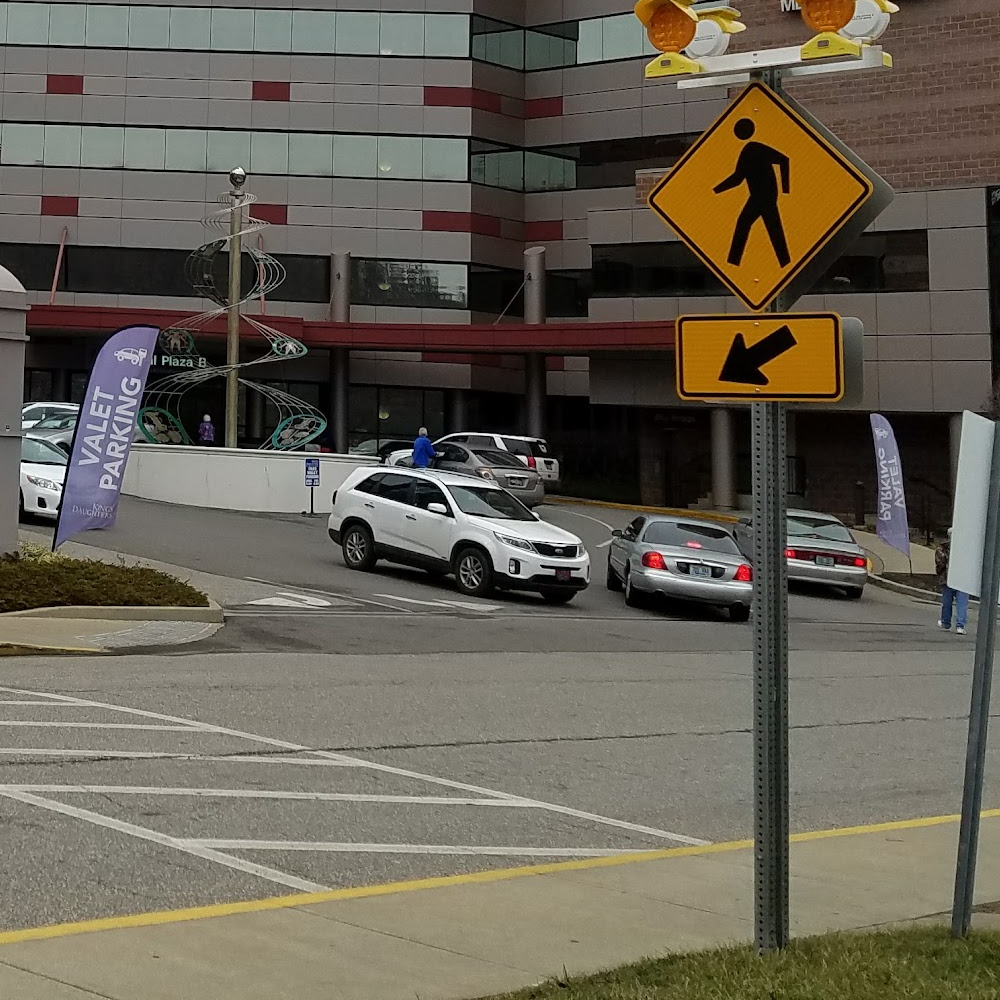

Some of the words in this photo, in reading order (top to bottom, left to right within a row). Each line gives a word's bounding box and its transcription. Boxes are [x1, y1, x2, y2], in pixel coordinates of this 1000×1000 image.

[161, 355, 194, 368] Plaza
[198, 357, 207, 368] B
[78, 386, 114, 466] VALET
[99, 376, 141, 491] PARKING
